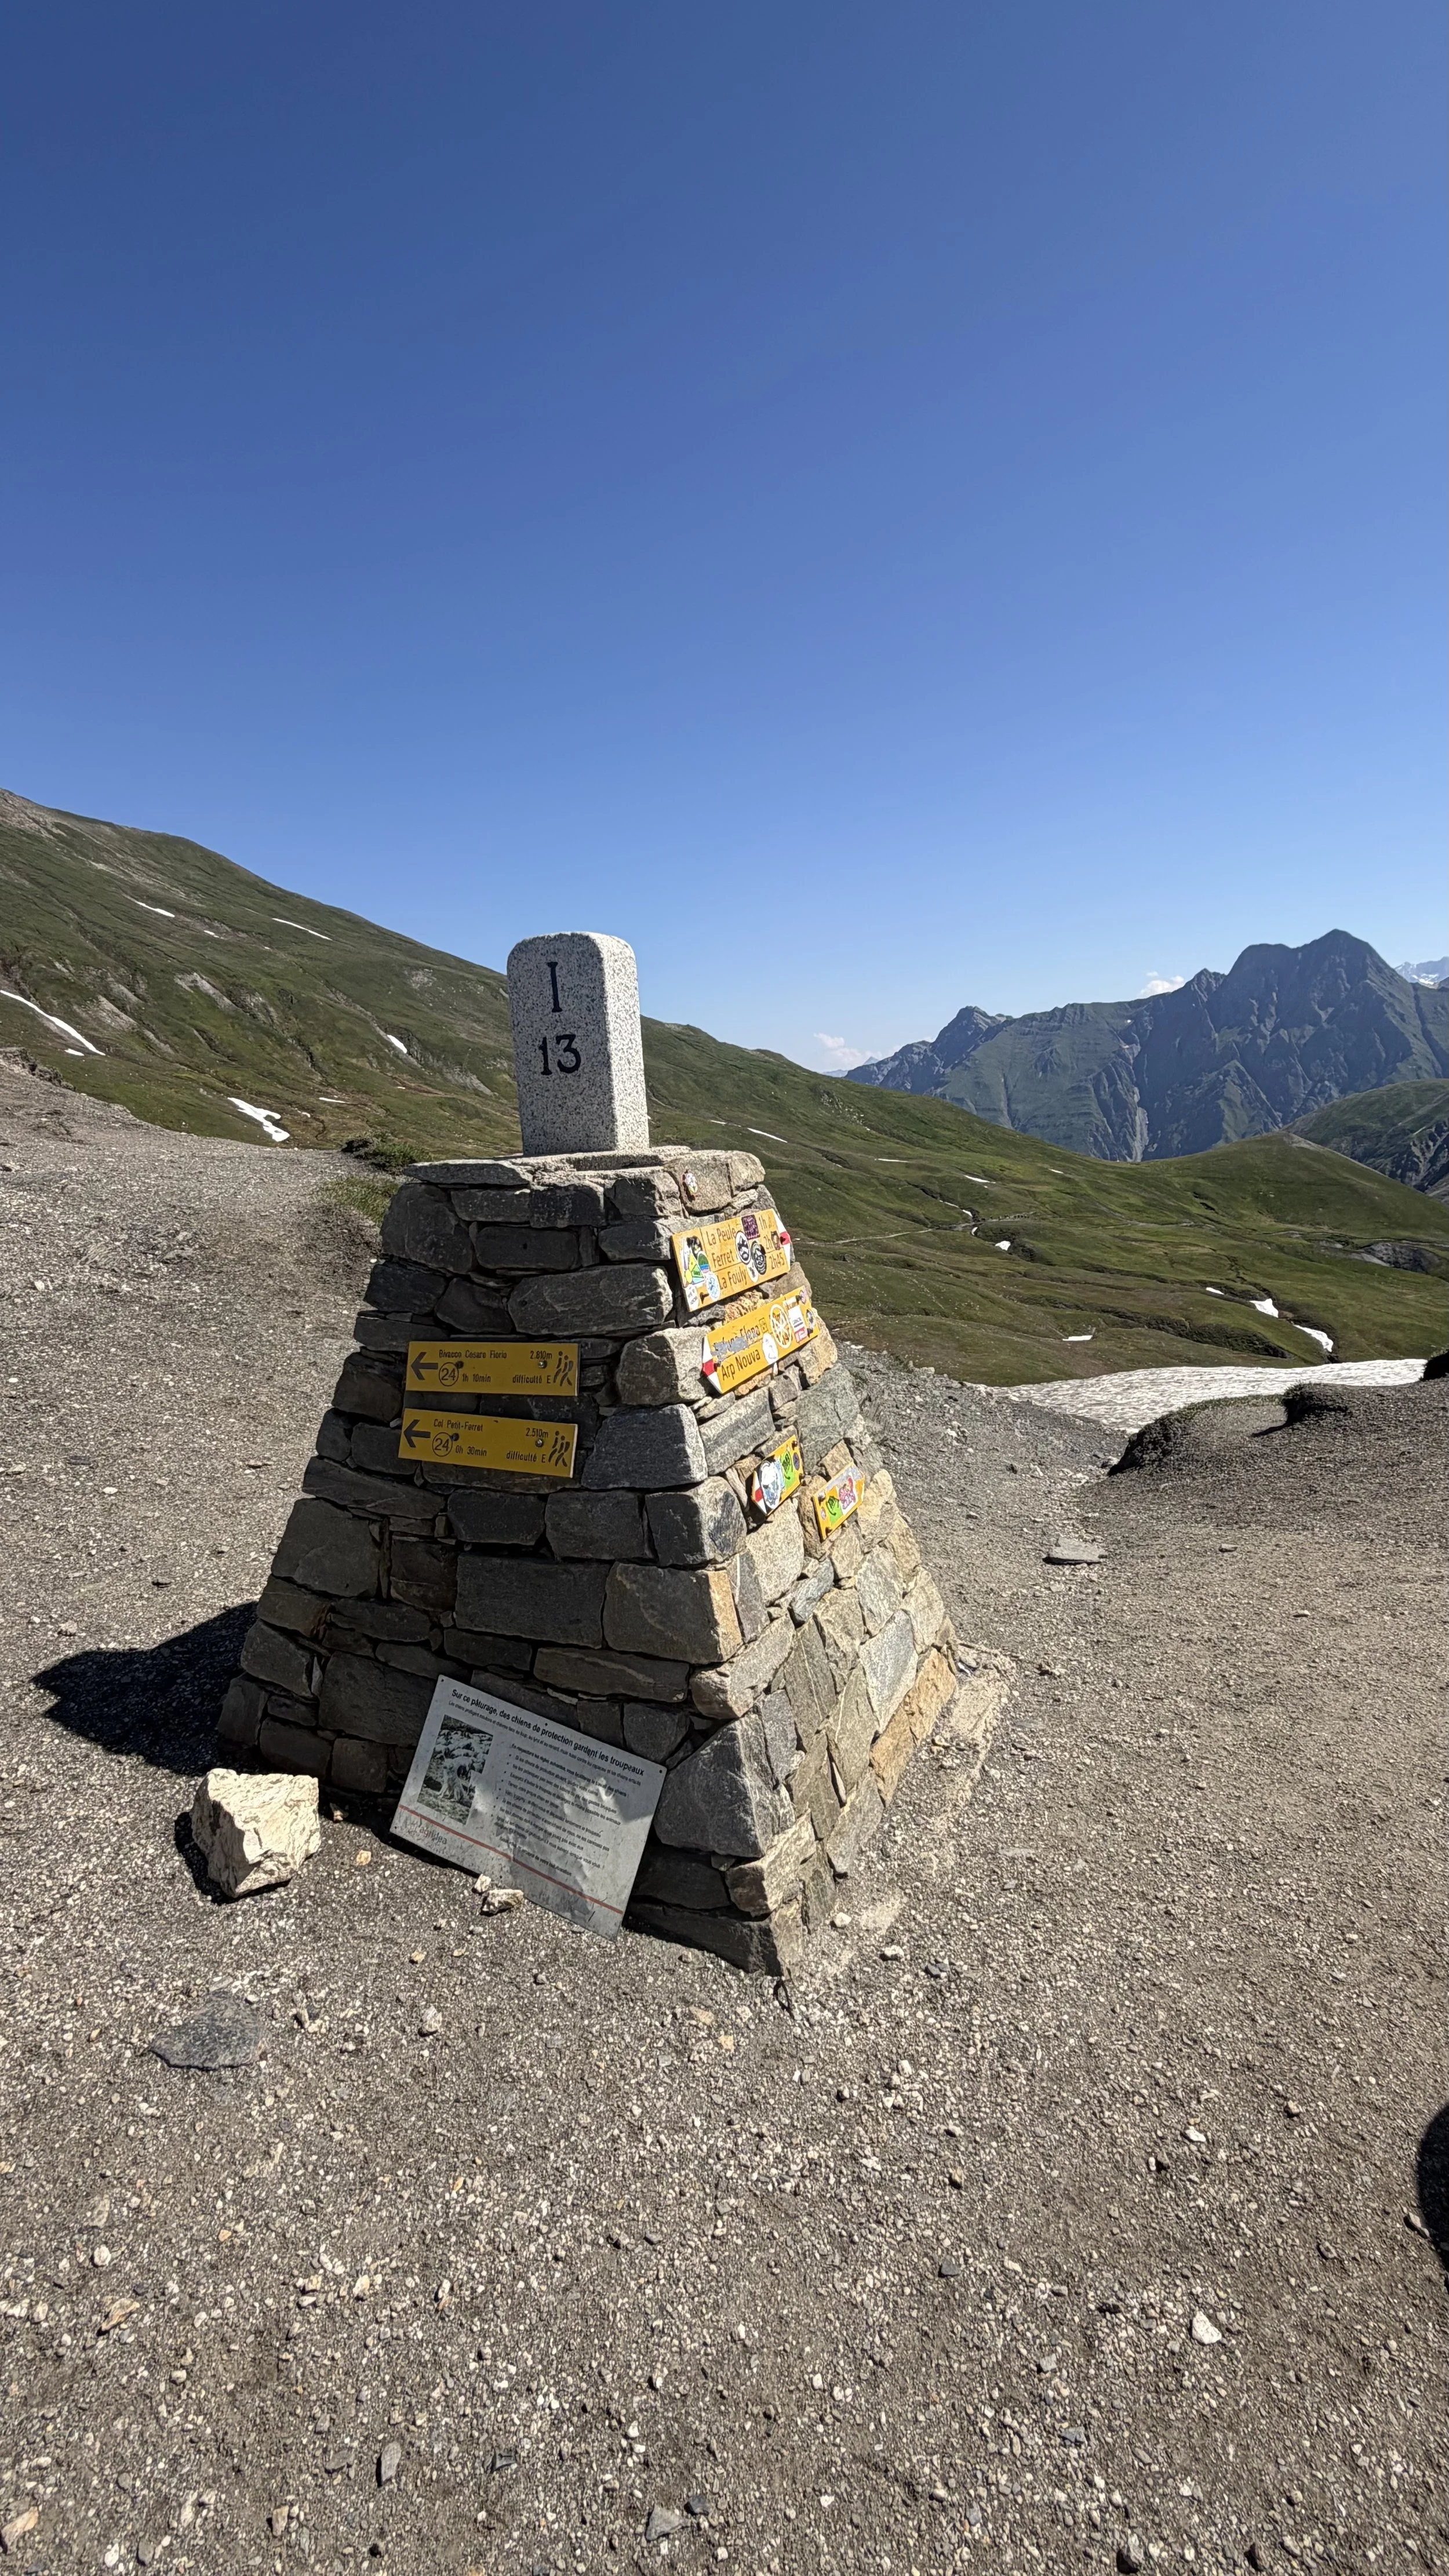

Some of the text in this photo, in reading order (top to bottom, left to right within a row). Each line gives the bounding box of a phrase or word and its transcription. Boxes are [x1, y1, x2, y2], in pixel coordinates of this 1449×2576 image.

[547, 961, 563, 1013] I
[538, 1034, 581, 1075] 13
[706, 1231, 716, 1246] La
[716, 1224, 736, 1243] Peule
[712, 1249, 734, 1268] Ferret
[769, 1253, 784, 1269] 2h45
[727, 1267, 747, 1286] Fouly
[465, 1350, 486, 1359] Cesare
[722, 1349, 760, 1381] Arp Nouva
[441, 1368, 456, 1381] 24
[463, 1373, 491, 1382] 1h 10min
[512, 1374, 551, 1384] difficulté E
[434, 1419, 483, 1432] Col Petit-Ferret
[526, 1427, 549, 1438] 2.510m
[435, 1438, 449, 1451] 24
[456, 1445, 487, 1456] 0h 30min
[506, 1451, 546, 1463] difficulté E
[452, 1689, 462, 1699] Sur
[470, 1698, 497, 1716] pâturage,
[499, 1709, 510, 1719] des
[511, 1715, 531, 1729] chiens
[532, 1723, 540, 1732] de
[540, 1729, 573, 1746] protection
[573, 1742, 598, 1758] gardent
[598, 1751, 608, 1762] les
[610, 1756, 644, 1775] troupeaux
